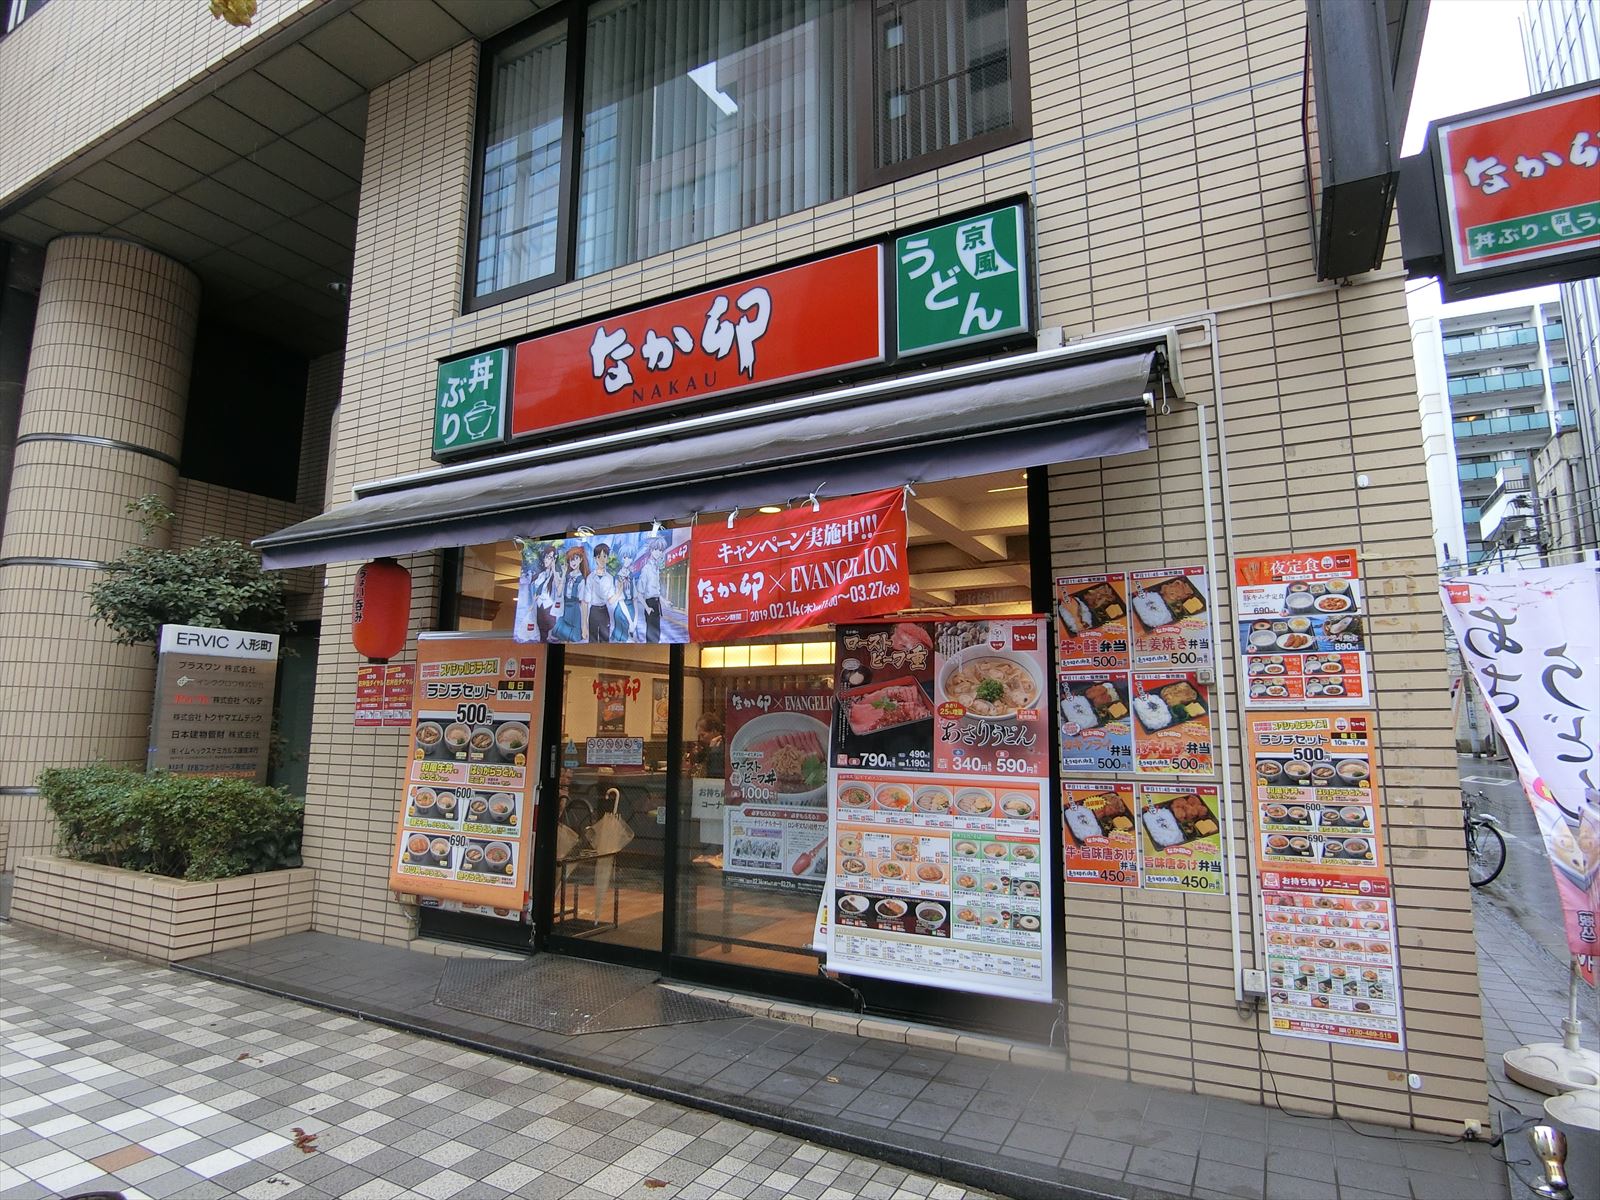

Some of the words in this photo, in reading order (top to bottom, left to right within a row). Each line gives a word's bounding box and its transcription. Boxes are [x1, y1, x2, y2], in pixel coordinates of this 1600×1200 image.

[960, 223, 1000, 278] 京風
[901, 238, 1004, 336] うどん
[590, 286, 773, 393] なか卯
[632, 372, 718, 404] NAKAU
[1270, 558, 1319, 576] 夜定食
[697, 572, 764, 605] なか卯
[176, 632, 229, 649] ERVIC
[236, 638, 273, 657] 人形町
[844, 632, 893, 651] ロースト
[1060, 640, 1127, 654] 牛・鮭弁当
[1135, 637, 1209, 653] 生姜焼き弁当
[870, 644, 928, 671] ビーフ重
[224, 664, 257, 674] 株式会社
[427, 682, 497, 700] ランチセット
[592, 677, 641, 704] なか卯
[213, 696, 240, 705] 株式会社
[731, 694, 772, 712] なか卯
[173, 713, 202, 721] 株式会社
[941, 719, 1037, 748] あさりうどん
[1259, 732, 1328, 746] ランチセット
[731, 760, 761, 772] ロースト
[743, 769, 777, 786] ビーフ丼
[1066, 846, 1136, 862] 牛・旨味唐あげ
[1120, 861, 1137, 872] 弁当
[1144, 856, 1222, 874] 旨味唐あげ弁当
[1281, 876, 1360, 889] お持ち帰りメニュー
